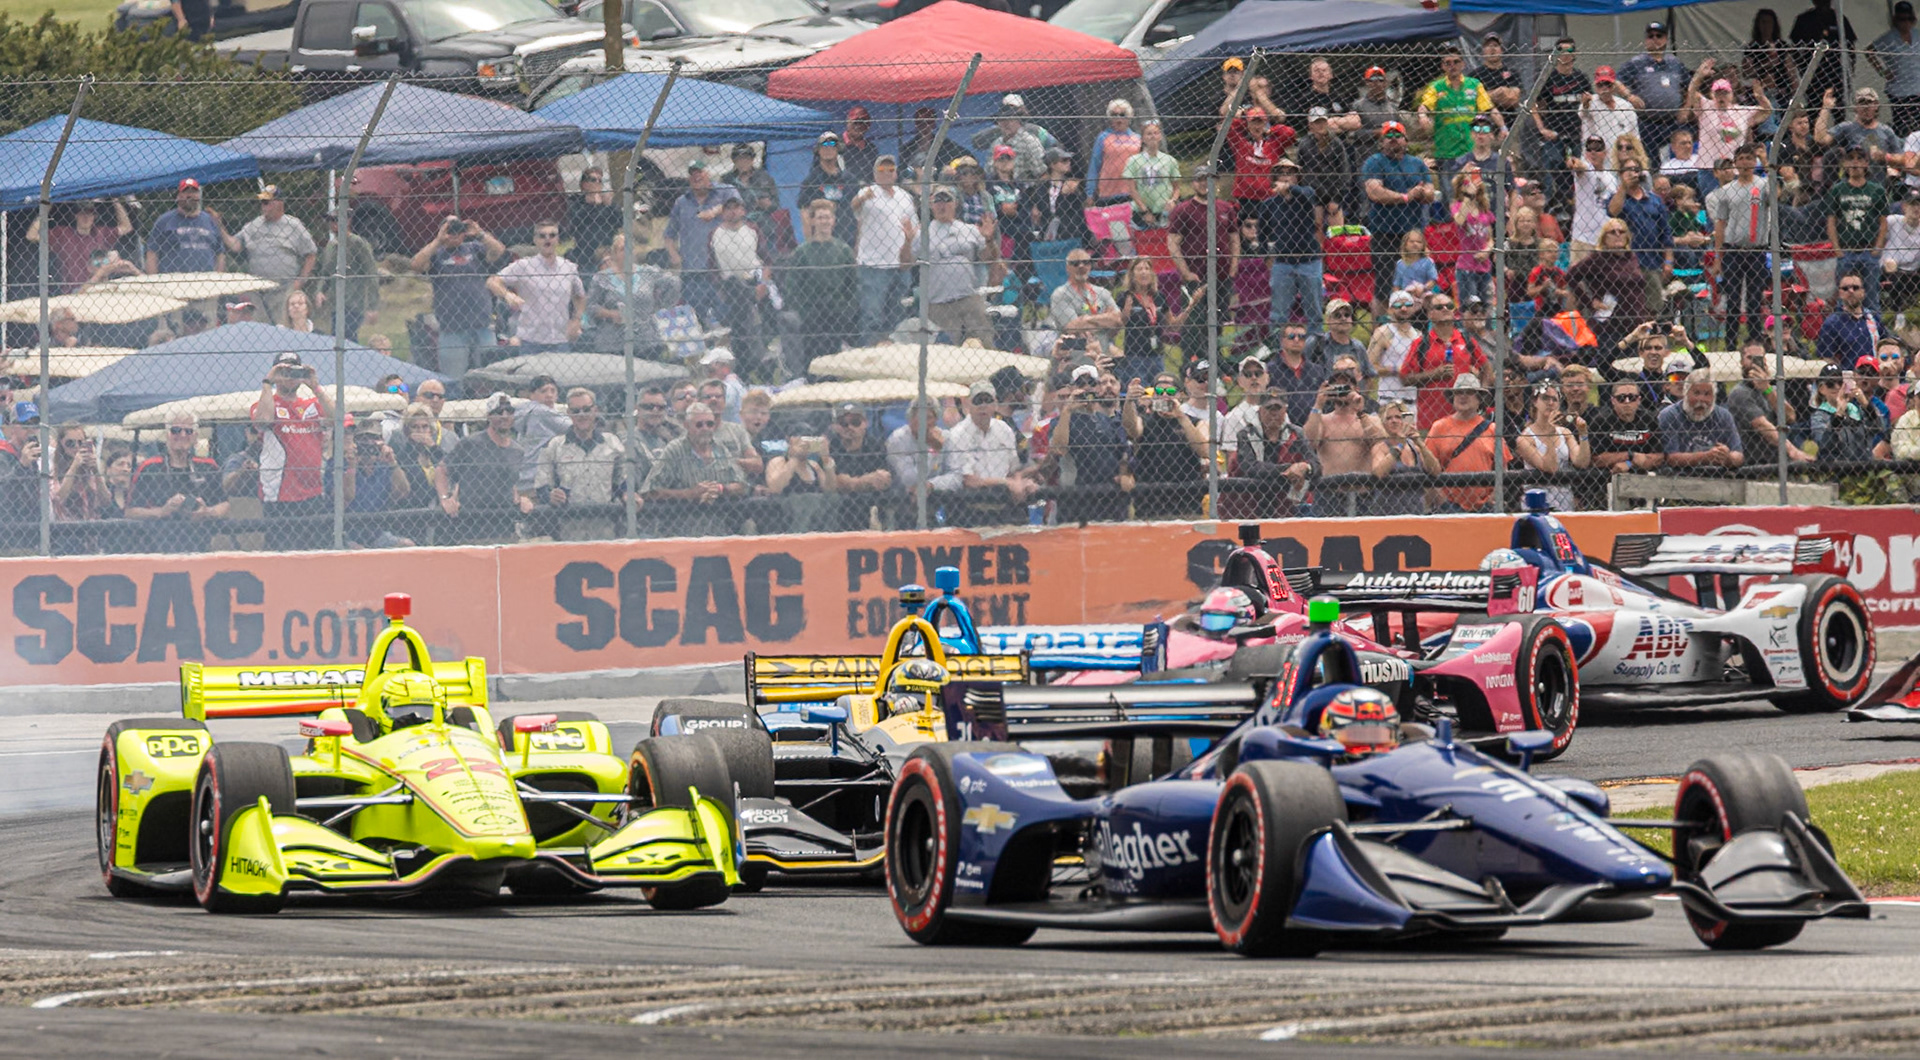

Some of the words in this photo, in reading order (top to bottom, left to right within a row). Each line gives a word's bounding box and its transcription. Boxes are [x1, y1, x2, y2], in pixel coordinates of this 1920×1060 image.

[846, 544, 1031, 592] POWER
[1833, 540, 1852, 568] 14
[1346, 571, 1491, 588] AutoNation
[555, 552, 808, 651] SCAG
[1517, 585, 1535, 613] 60
[1620, 615, 1694, 660] ABC
[1613, 662, 1655, 679] Supply
[147, 736, 199, 757] PPG
